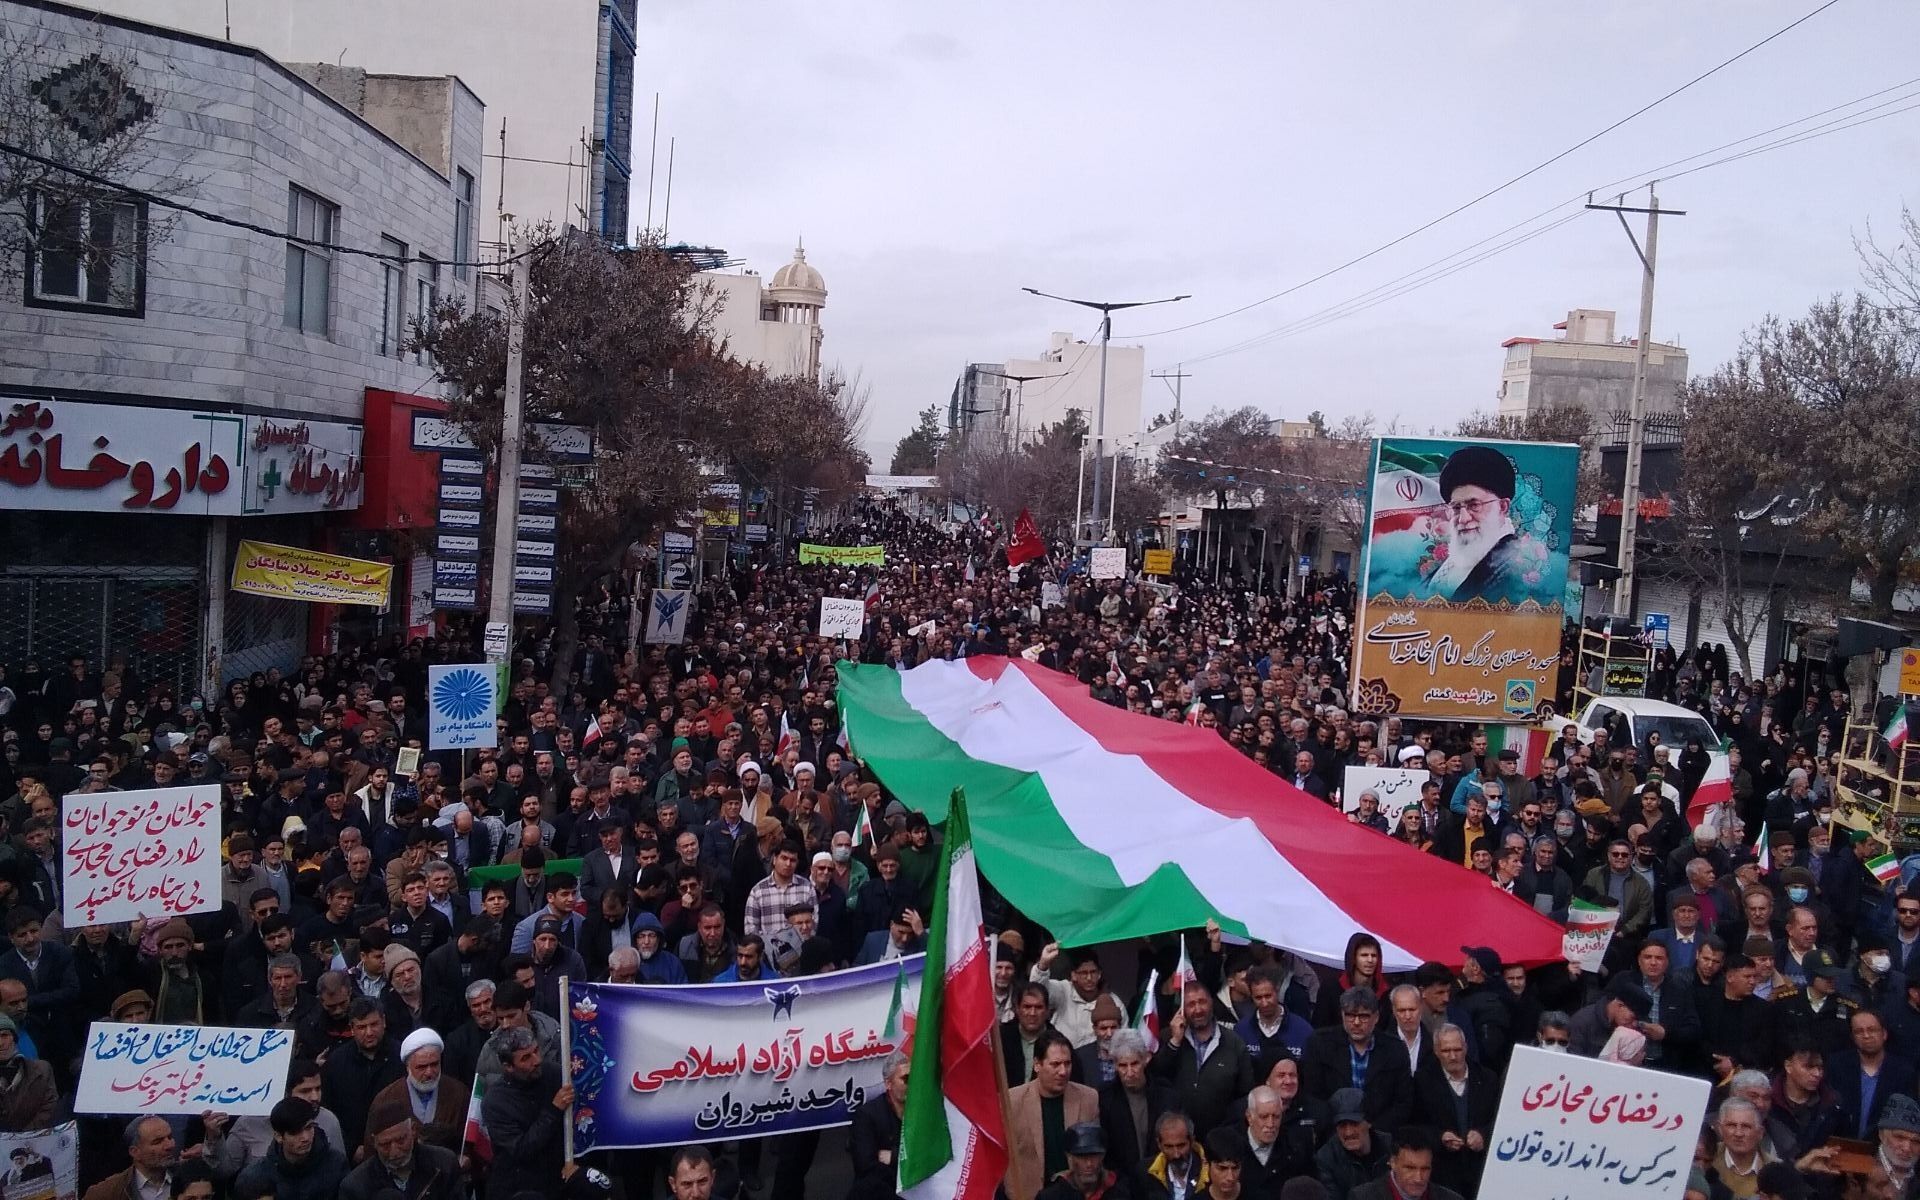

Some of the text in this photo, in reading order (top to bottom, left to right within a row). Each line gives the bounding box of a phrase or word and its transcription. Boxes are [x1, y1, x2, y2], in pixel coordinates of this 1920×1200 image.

[418, 421, 433, 444] خیام
[0, 432, 229, 508] داروخانه
[287, 446, 360, 507] داروخانه
[245, 555, 381, 586] مطب دکتر میلاد شایگان
[463, 562, 475, 573] دکتر
[1430, 634, 1461, 675] امام
[1461, 630, 1496, 676] بزرگ
[1491, 648, 1532, 672] مصلای
[1527, 656, 1537, 670] و
[1534, 649, 1561, 683] مسجد
[1423, 686, 1497, 705] مزار شهید گمنام
[434, 720, 492, 733] دانشگاه پیام نور
[449, 733, 477, 744] شیروان
[1373, 771, 1412, 794] دشمن در
[145, 800, 159, 818] و
[145, 793, 214, 835] جوانان
[66, 836, 205, 878] را در فضای مجازی
[74, 868, 205, 921] بی پناه رها نکنید
[90, 1026, 288, 1064] مشکل جوانان اشتغال و اقتصاد
[752, 1027, 804, 1083] آزاد
[631, 1041, 747, 1092] اسلامی
[192, 1084, 212, 1102] نه
[694, 1077, 866, 1131] واحد شیروان
[1522, 1073, 1684, 1131] در فضای مجازی
[1496, 1130, 1677, 1192] هر کس به اندازه توان
